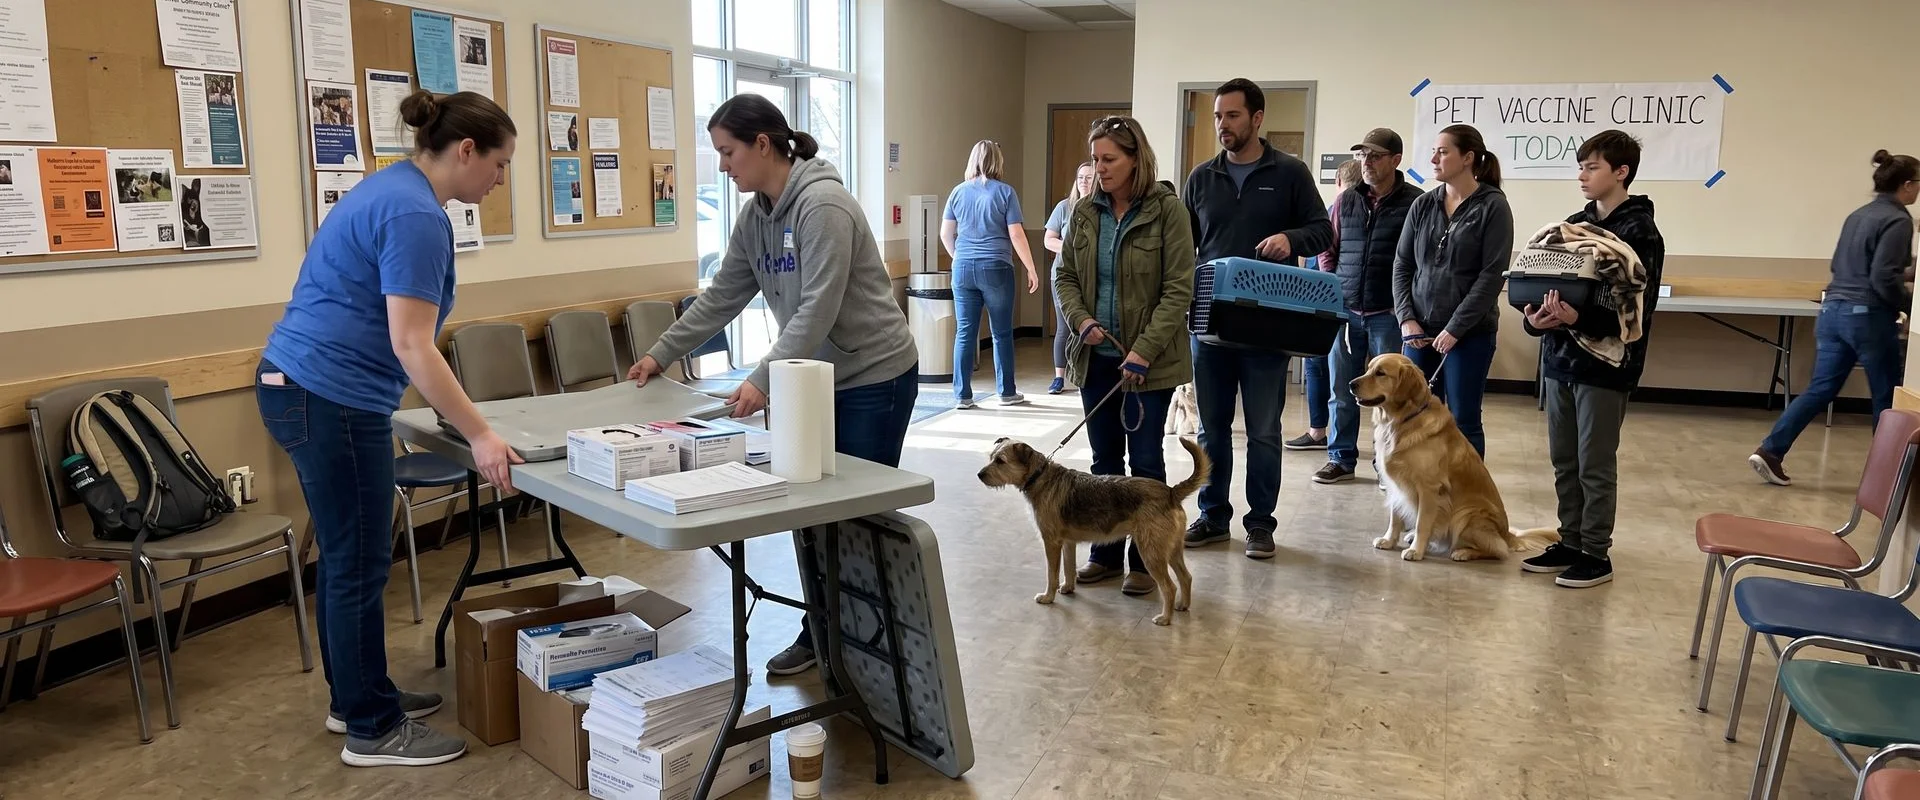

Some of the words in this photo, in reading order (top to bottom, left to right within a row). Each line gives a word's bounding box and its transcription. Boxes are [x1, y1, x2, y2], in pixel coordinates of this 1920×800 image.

[1433, 96, 1484, 125] PET
[1497, 96, 1597, 124] VACCINE
[1610, 95, 1706, 125] CLINIC
[1505, 135, 1586, 161] TODA
